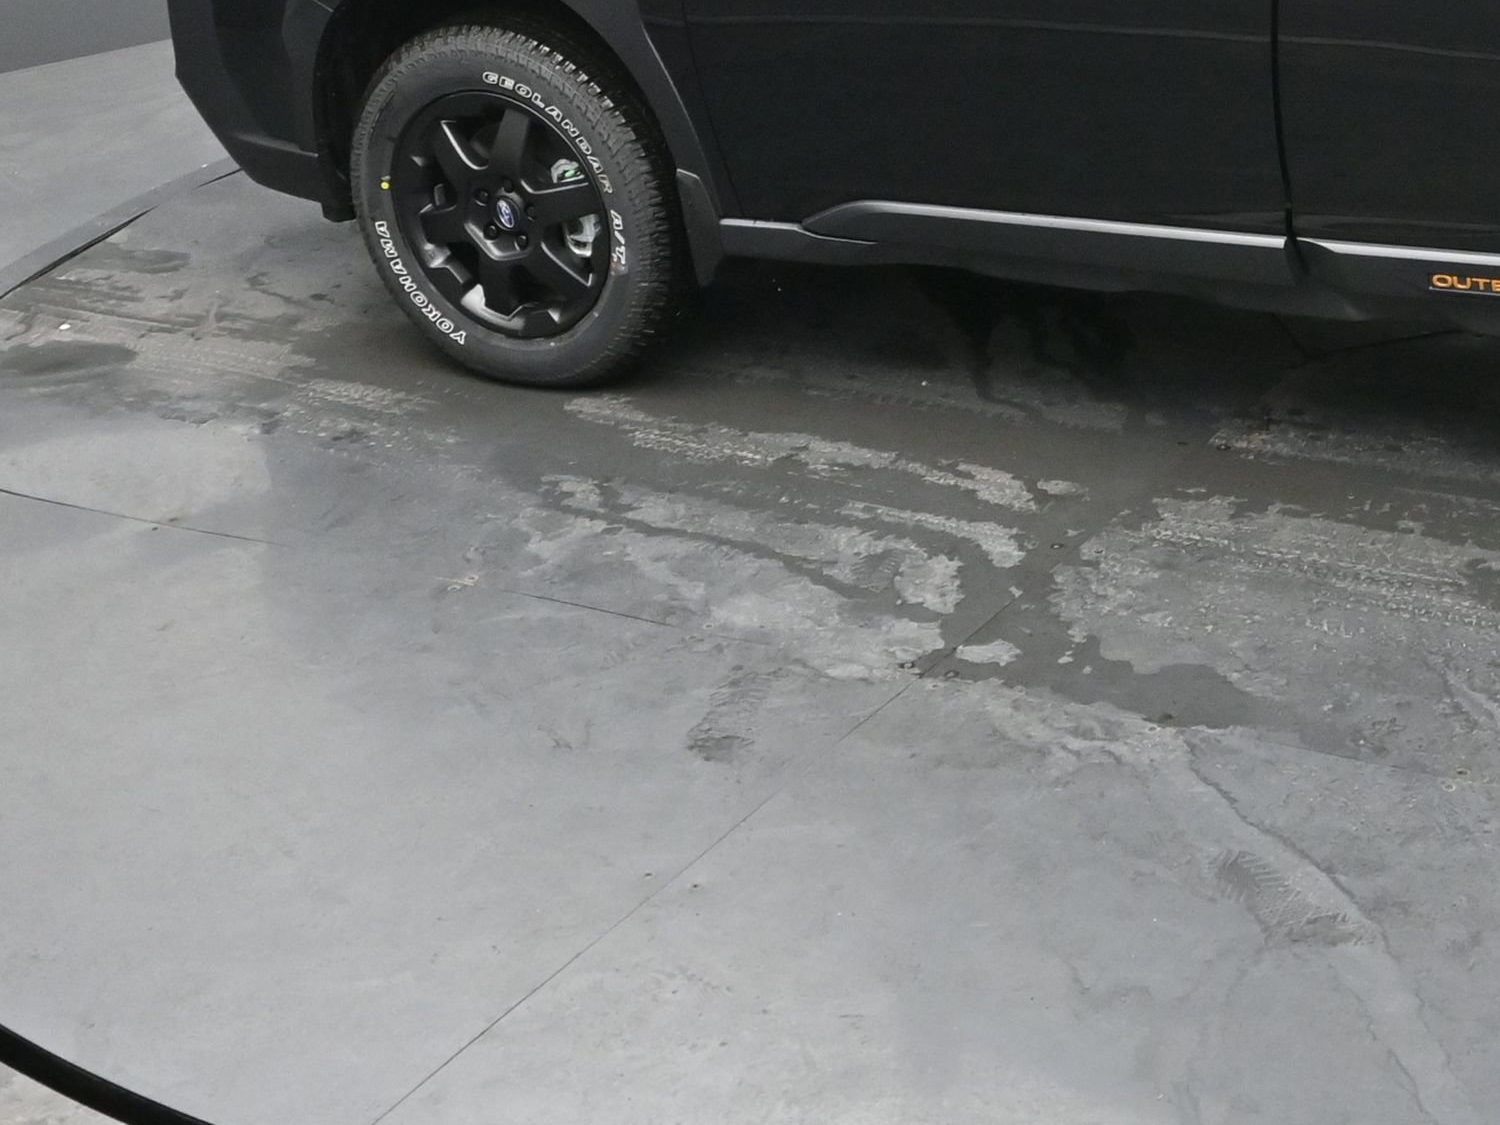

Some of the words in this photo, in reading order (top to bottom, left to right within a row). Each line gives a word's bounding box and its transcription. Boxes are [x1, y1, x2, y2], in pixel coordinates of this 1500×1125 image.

[482, 71, 613, 194] GEOLANDAR
[610, 209, 626, 264] A/T
[375, 220, 466, 345] YOKOHAMA
